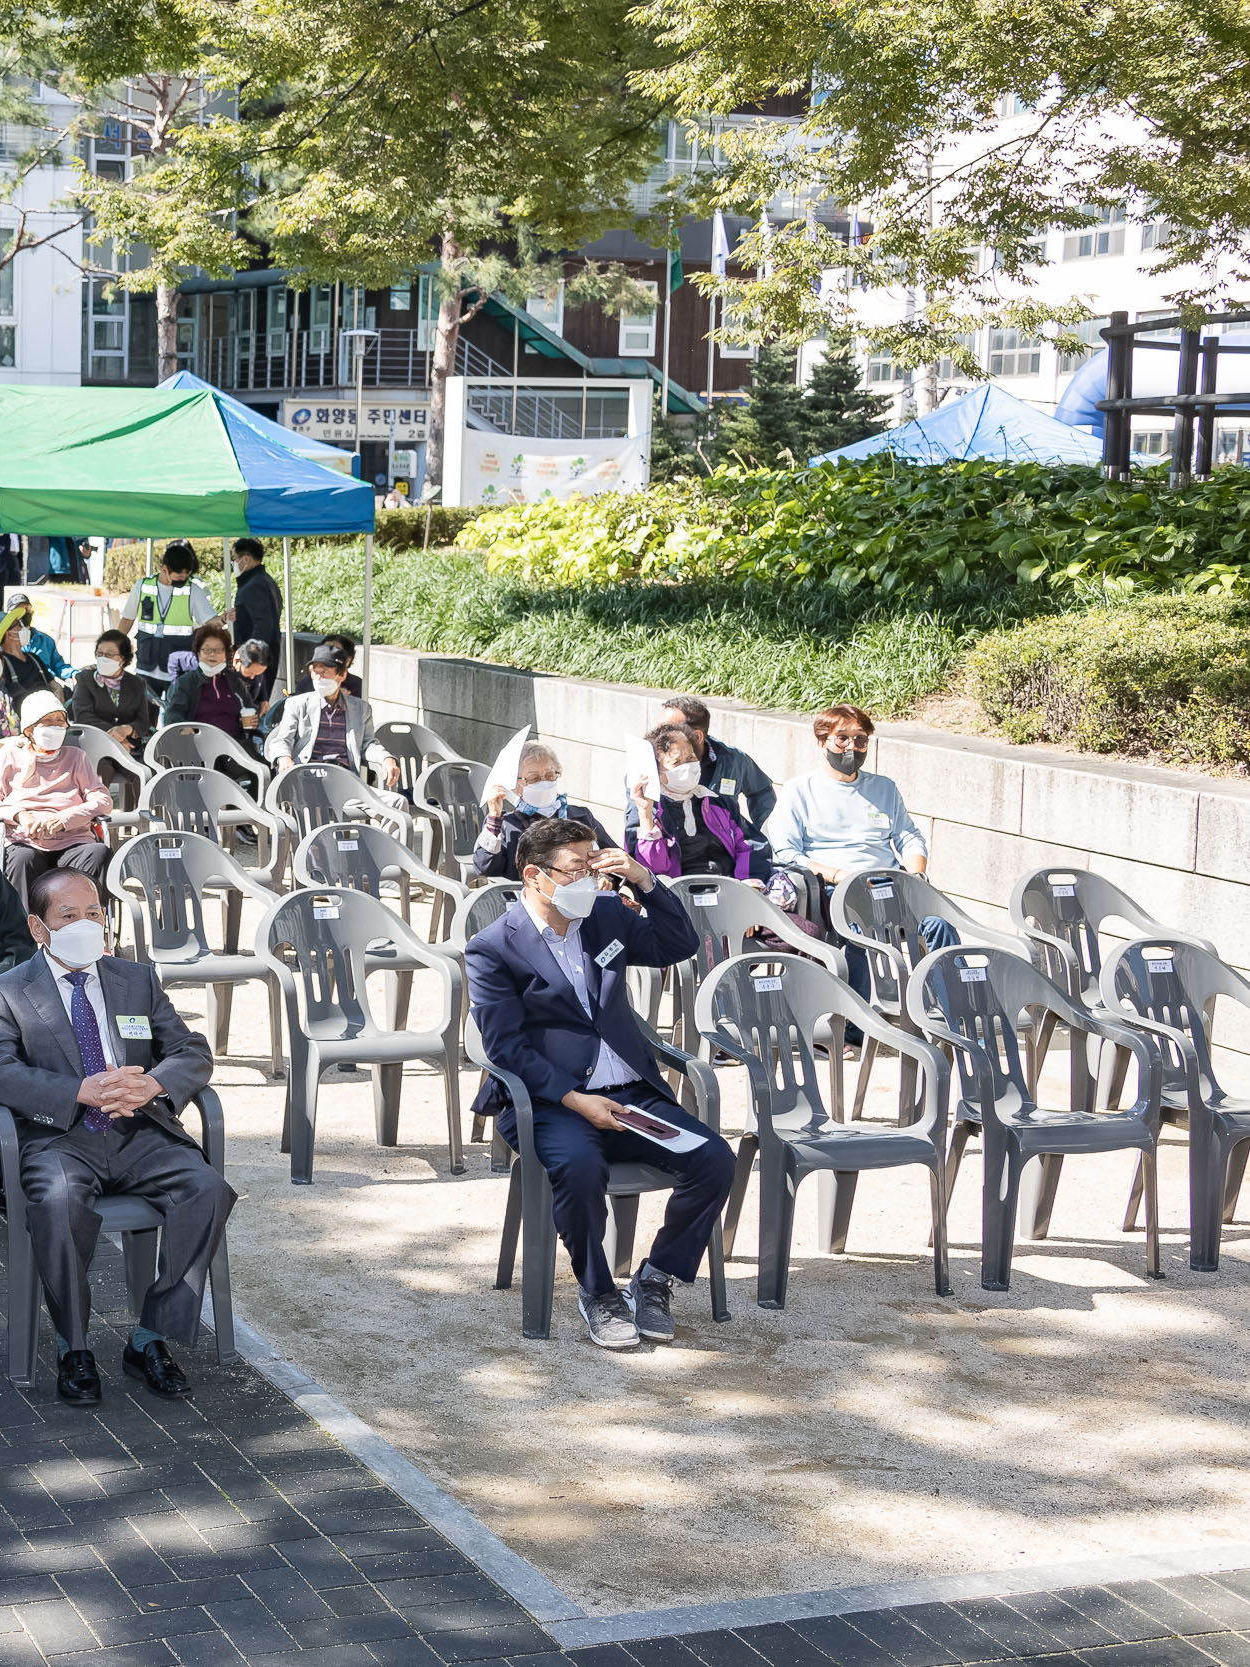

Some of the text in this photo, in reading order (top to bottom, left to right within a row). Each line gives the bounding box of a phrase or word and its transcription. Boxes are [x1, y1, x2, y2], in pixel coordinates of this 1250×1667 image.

[316, 407, 427, 425] 화양동 주민센터
[408, 429, 426, 438] 2층
